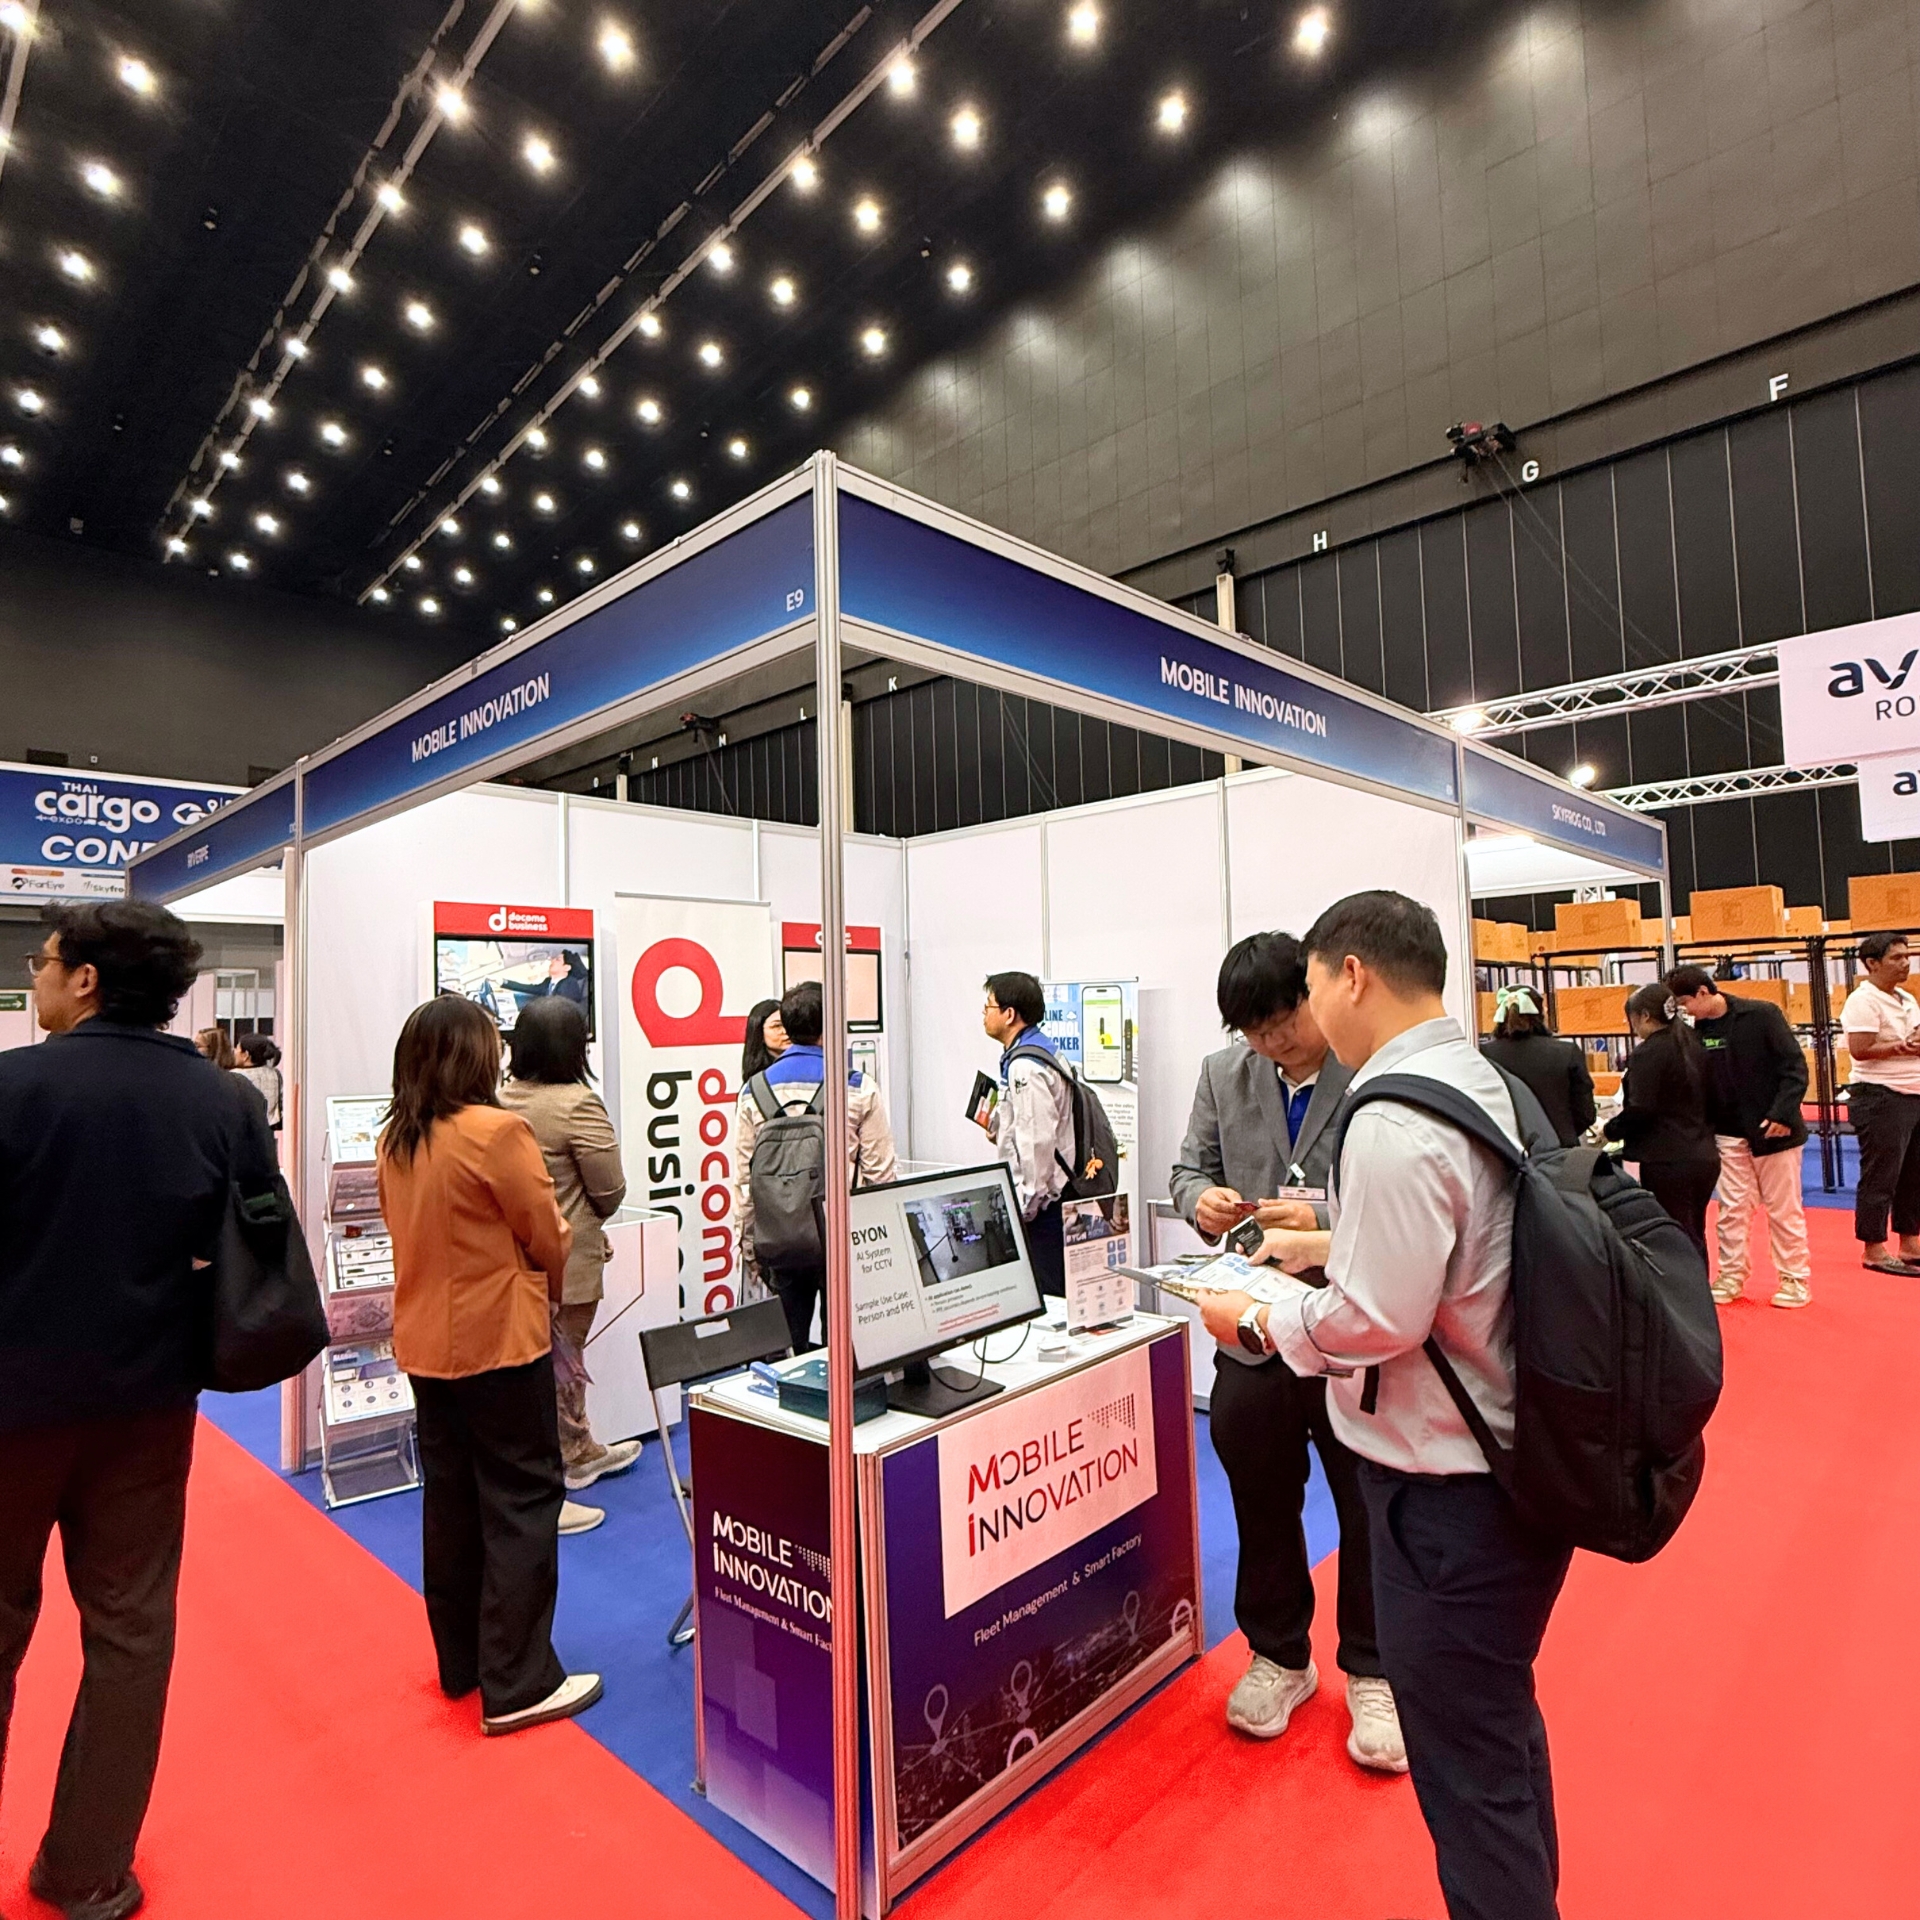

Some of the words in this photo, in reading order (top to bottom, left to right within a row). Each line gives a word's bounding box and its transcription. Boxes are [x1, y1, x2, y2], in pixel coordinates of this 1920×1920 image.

[1769, 373, 1789, 402] F
[1522, 460, 1540, 482] G
[1313, 530, 1328, 552] H
[786, 588, 804, 612] E9
[888, 675, 898, 692] K
[1160, 656, 1230, 705] MOBILE
[1234, 683, 1327, 738] INNOVATION
[1875, 695, 1920, 721] RO
[411, 719, 457, 763] MOBILE
[460, 672, 550, 740] INNOVATION
[799, 707, 807, 721] L
[61, 781, 99, 794] THAI
[34, 790, 161, 834] cargo
[92, 885, 125, 893] Skyfro
[508, 911, 547, 923] docomo
[508, 921, 549, 932] business
[1044, 1009, 1063, 1022] LINE
[851, 1224, 888, 1246] BYON
[865, 1247, 891, 1261] System
[861, 1263, 873, 1274] for
[873, 1257, 893, 1271] CCTV
[855, 1298, 880, 1313] Sample
[858, 1309, 886, 1325] Person
[885, 1303, 901, 1317] and
[900, 1299, 915, 1312] PPE
[968, 1418, 1085, 1505] MOBILE
[713, 1510, 793, 1569] MOBILE
[973, 1619, 1001, 1647] Fleet
[1002, 1579, 1068, 1629] Management
[1071, 1570, 1081, 1586] &
[1084, 1553, 1111, 1579] Smart
[1111, 1533, 1142, 1559] Factory
[733, 1594, 780, 1627] Management
[780, 1617, 789, 1631] &
[789, 1621, 814, 1644] Smart
[814, 1632, 834, 1655] Fact
